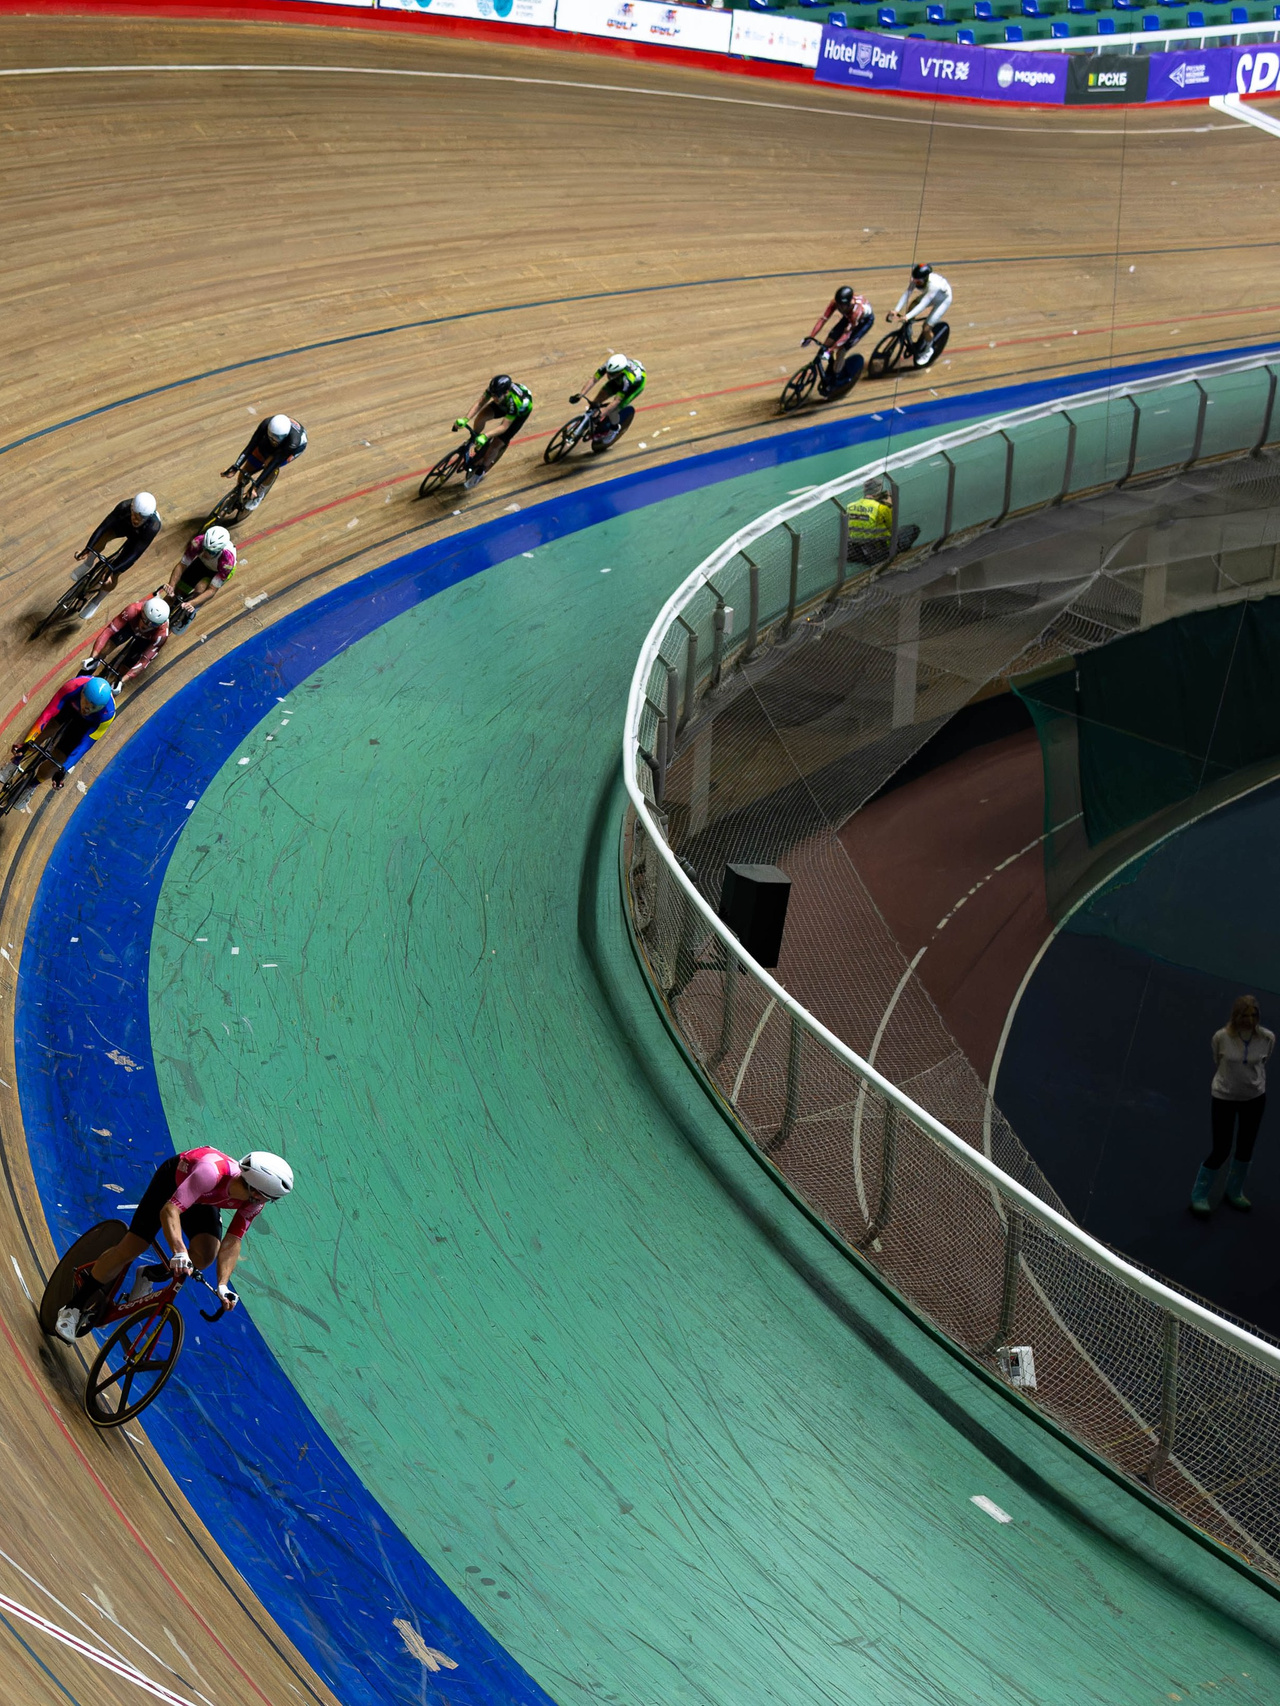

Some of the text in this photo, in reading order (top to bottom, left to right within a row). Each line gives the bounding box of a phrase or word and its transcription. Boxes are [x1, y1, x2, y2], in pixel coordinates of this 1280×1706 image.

[824, 38, 899, 71] Hotel Park
[1014, 70, 1056, 87] Magene
